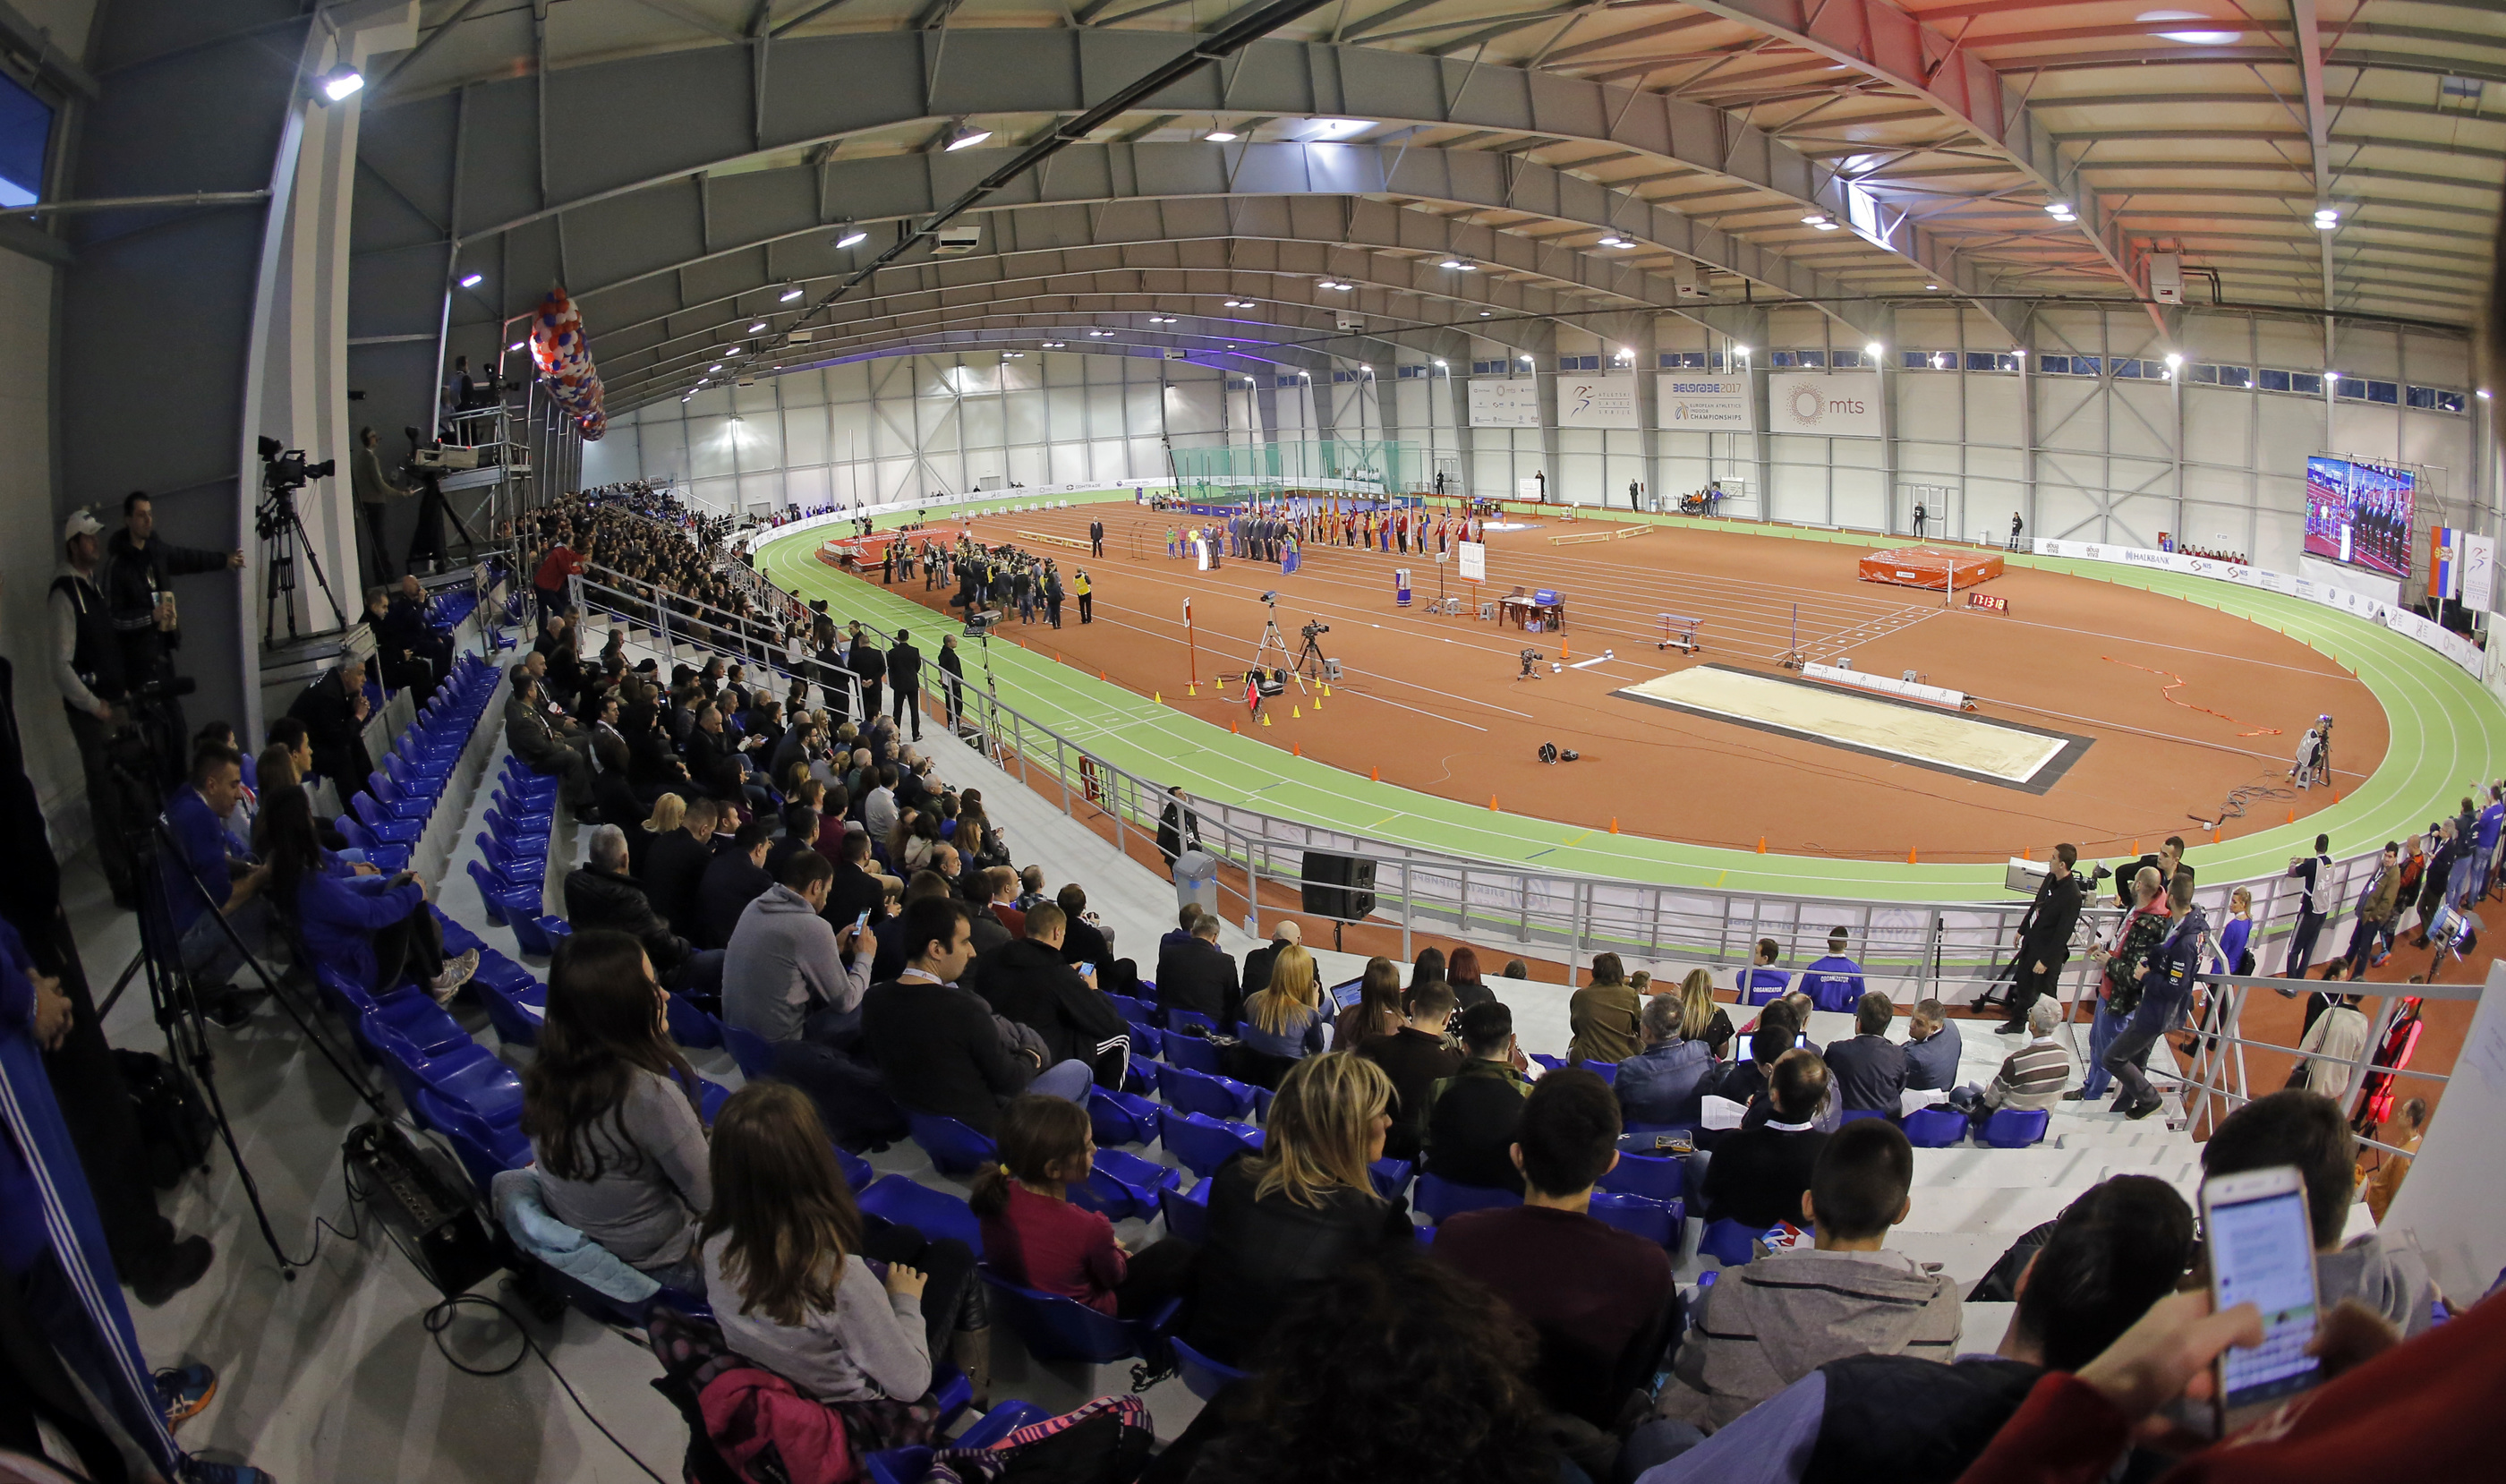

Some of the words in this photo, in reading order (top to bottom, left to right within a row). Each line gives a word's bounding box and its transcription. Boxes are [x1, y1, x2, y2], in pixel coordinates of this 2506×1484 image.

[1720, 383, 1742, 393] 2017
[1829, 397, 1864, 414] mts
[2133, 552, 2170, 565] HALKBANK
[1820, 976, 1849, 984] ORGANIZATOR
